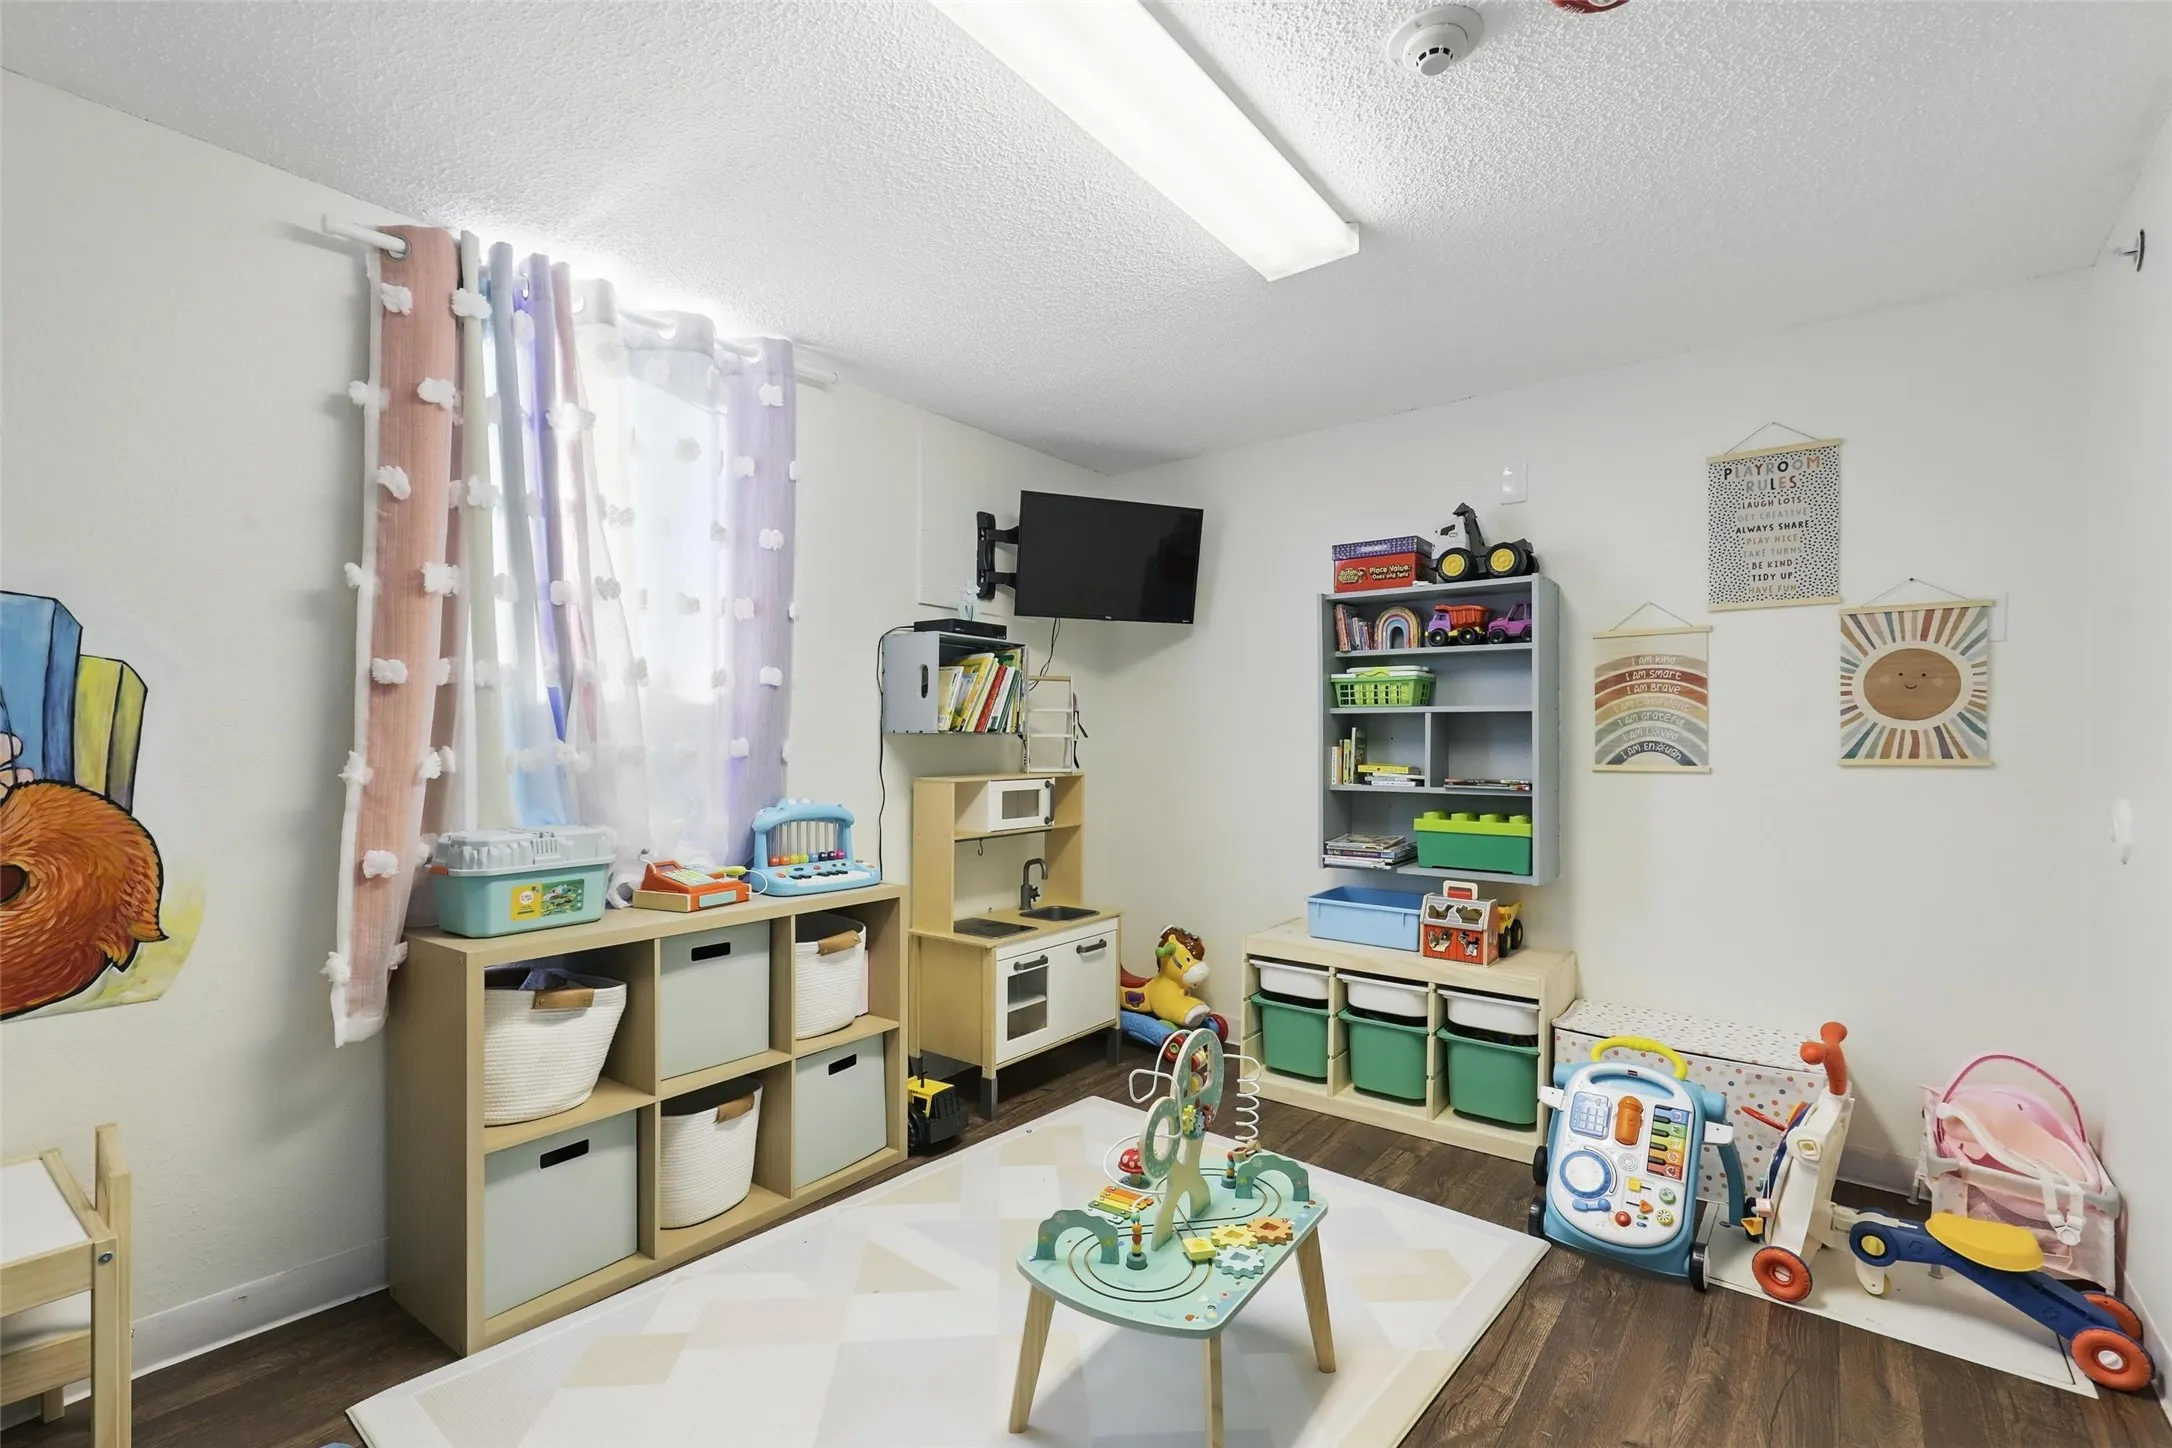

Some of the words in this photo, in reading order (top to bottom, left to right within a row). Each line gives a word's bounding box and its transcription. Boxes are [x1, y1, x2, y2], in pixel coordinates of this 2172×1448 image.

[1724, 456, 1820, 480] PLAYROOM
[1746, 476, 1797, 493] RULES
[1742, 500, 1774, 509] LAUGH
[1779, 496, 1802, 505] LOTS
[1737, 512, 1754, 521] GET
[1760, 508, 1807, 520] CREATIVE
[1736, 523, 1774, 534] ALWAYS
[1779, 520, 1809, 529] SHARE
[1746, 535, 1769, 545] PLAY
[1775, 534, 1798, 543] NICE
[1743, 549, 1766, 558] TAKE
[1772, 547, 1802, 556] TURNS
[1768, 560, 1792, 568] KIND
[1752, 573, 1776, 582] TIDY
[1749, 586, 1772, 594] HAVE
[1778, 584, 1797, 592] FUN
[1633, 671, 1646, 679] AM
[1650, 670, 1681, 680] Smart
[1634, 684, 1647, 693] AM
[1651, 683, 1680, 693] Brave
